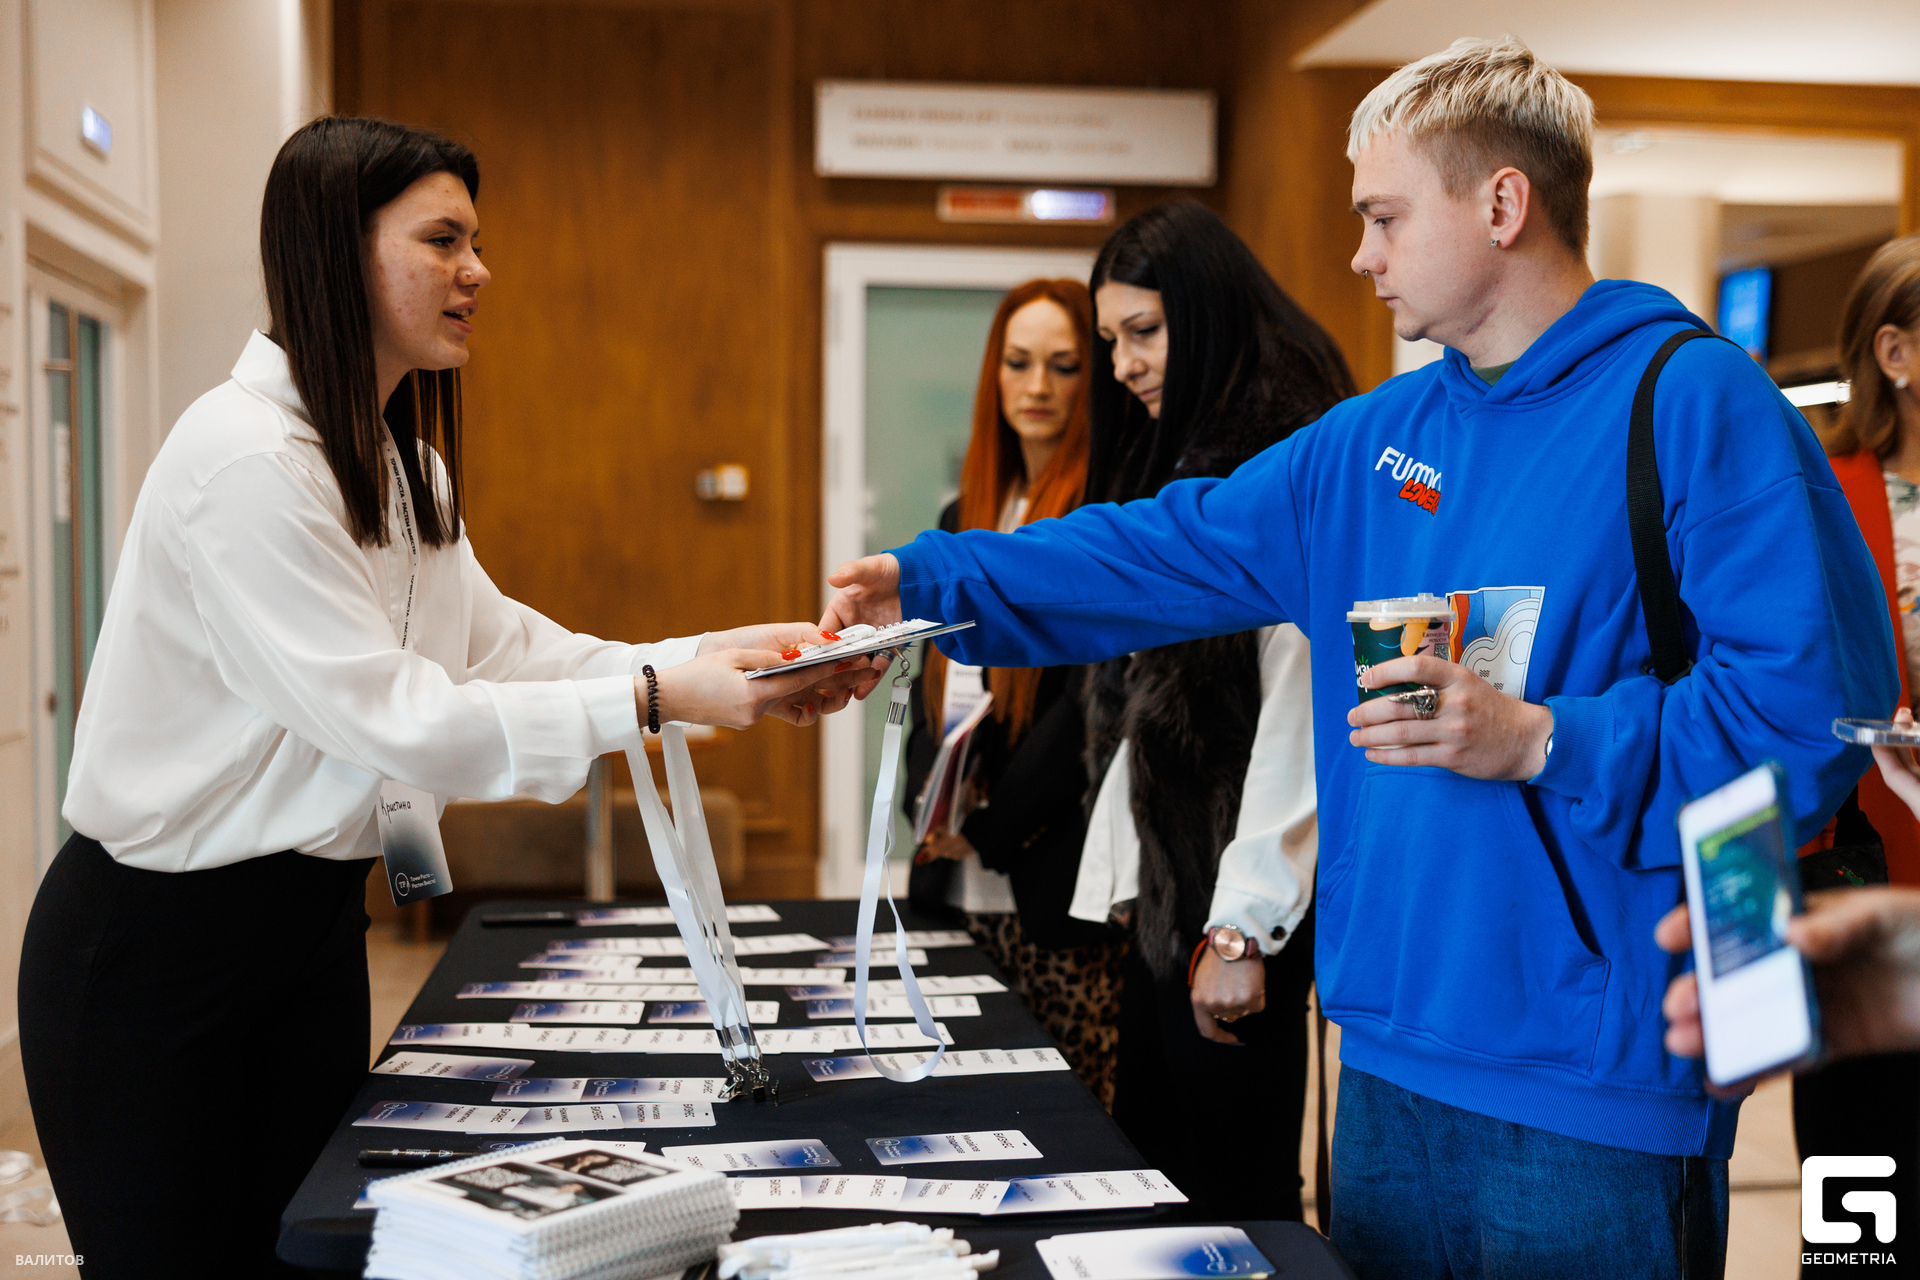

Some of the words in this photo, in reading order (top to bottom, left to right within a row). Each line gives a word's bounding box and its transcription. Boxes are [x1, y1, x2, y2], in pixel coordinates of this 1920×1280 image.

[396, 477, 405, 498] РОСТА
[490, 1108, 512, 1123] БИЗНЕС
[590, 1106, 604, 1121] БИЗНЕС
[683, 1104, 695, 1118] БИЗНЕС
[992, 1133, 1015, 1149] БИЗНЕС
[769, 1179, 782, 1196] БИЗНЕС
[869, 1178, 886, 1197] БИЗНЕС
[1095, 1178, 1121, 1196] БИЗНЕС
[1132, 1172, 1158, 1190] БИЗНЕС
[969, 1183, 990, 1200] БИЗНЕС
